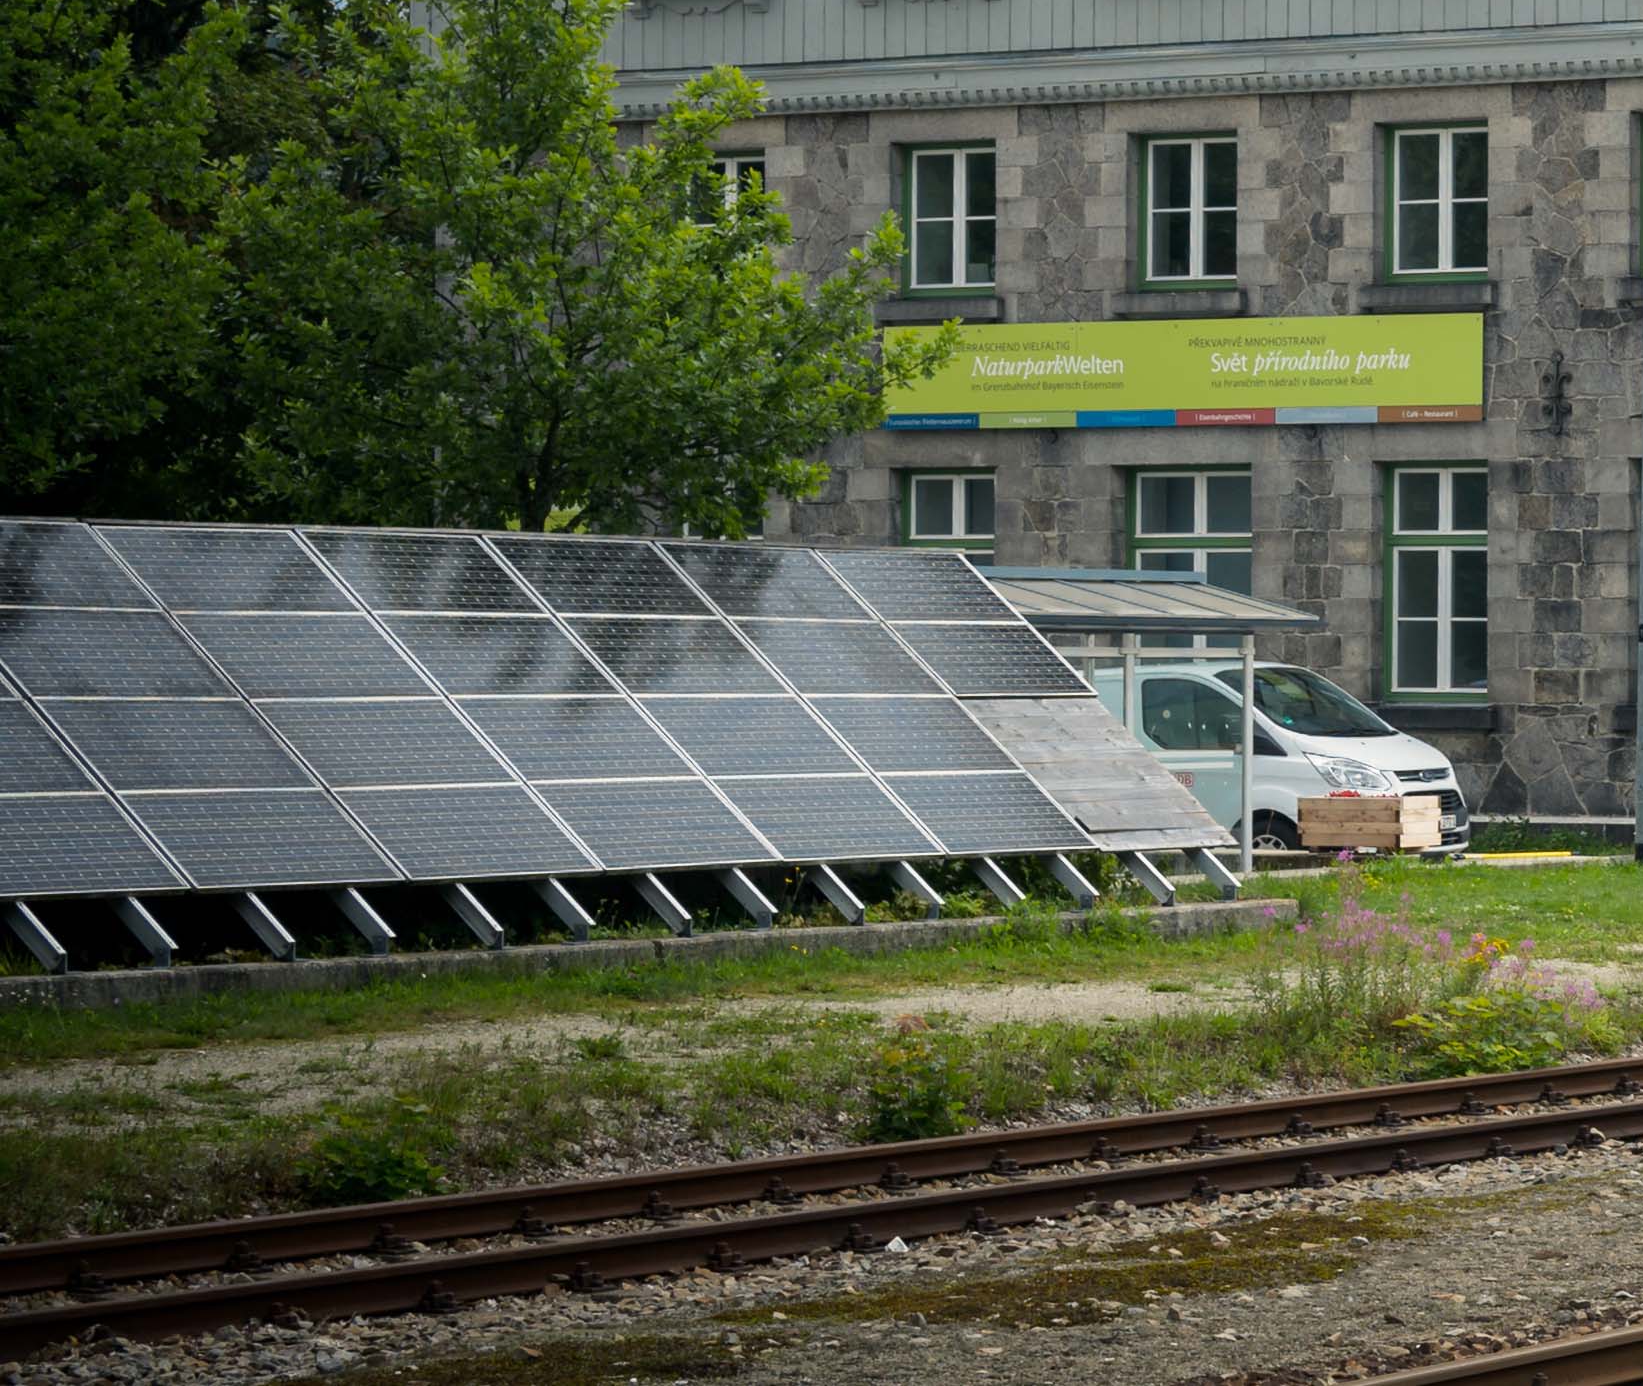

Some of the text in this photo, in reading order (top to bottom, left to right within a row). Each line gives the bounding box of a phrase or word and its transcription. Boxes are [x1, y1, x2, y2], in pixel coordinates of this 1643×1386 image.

[971, 354, 1124, 380] NaturparkWelten
[1210, 347, 1411, 376] Svět přírodního parku
